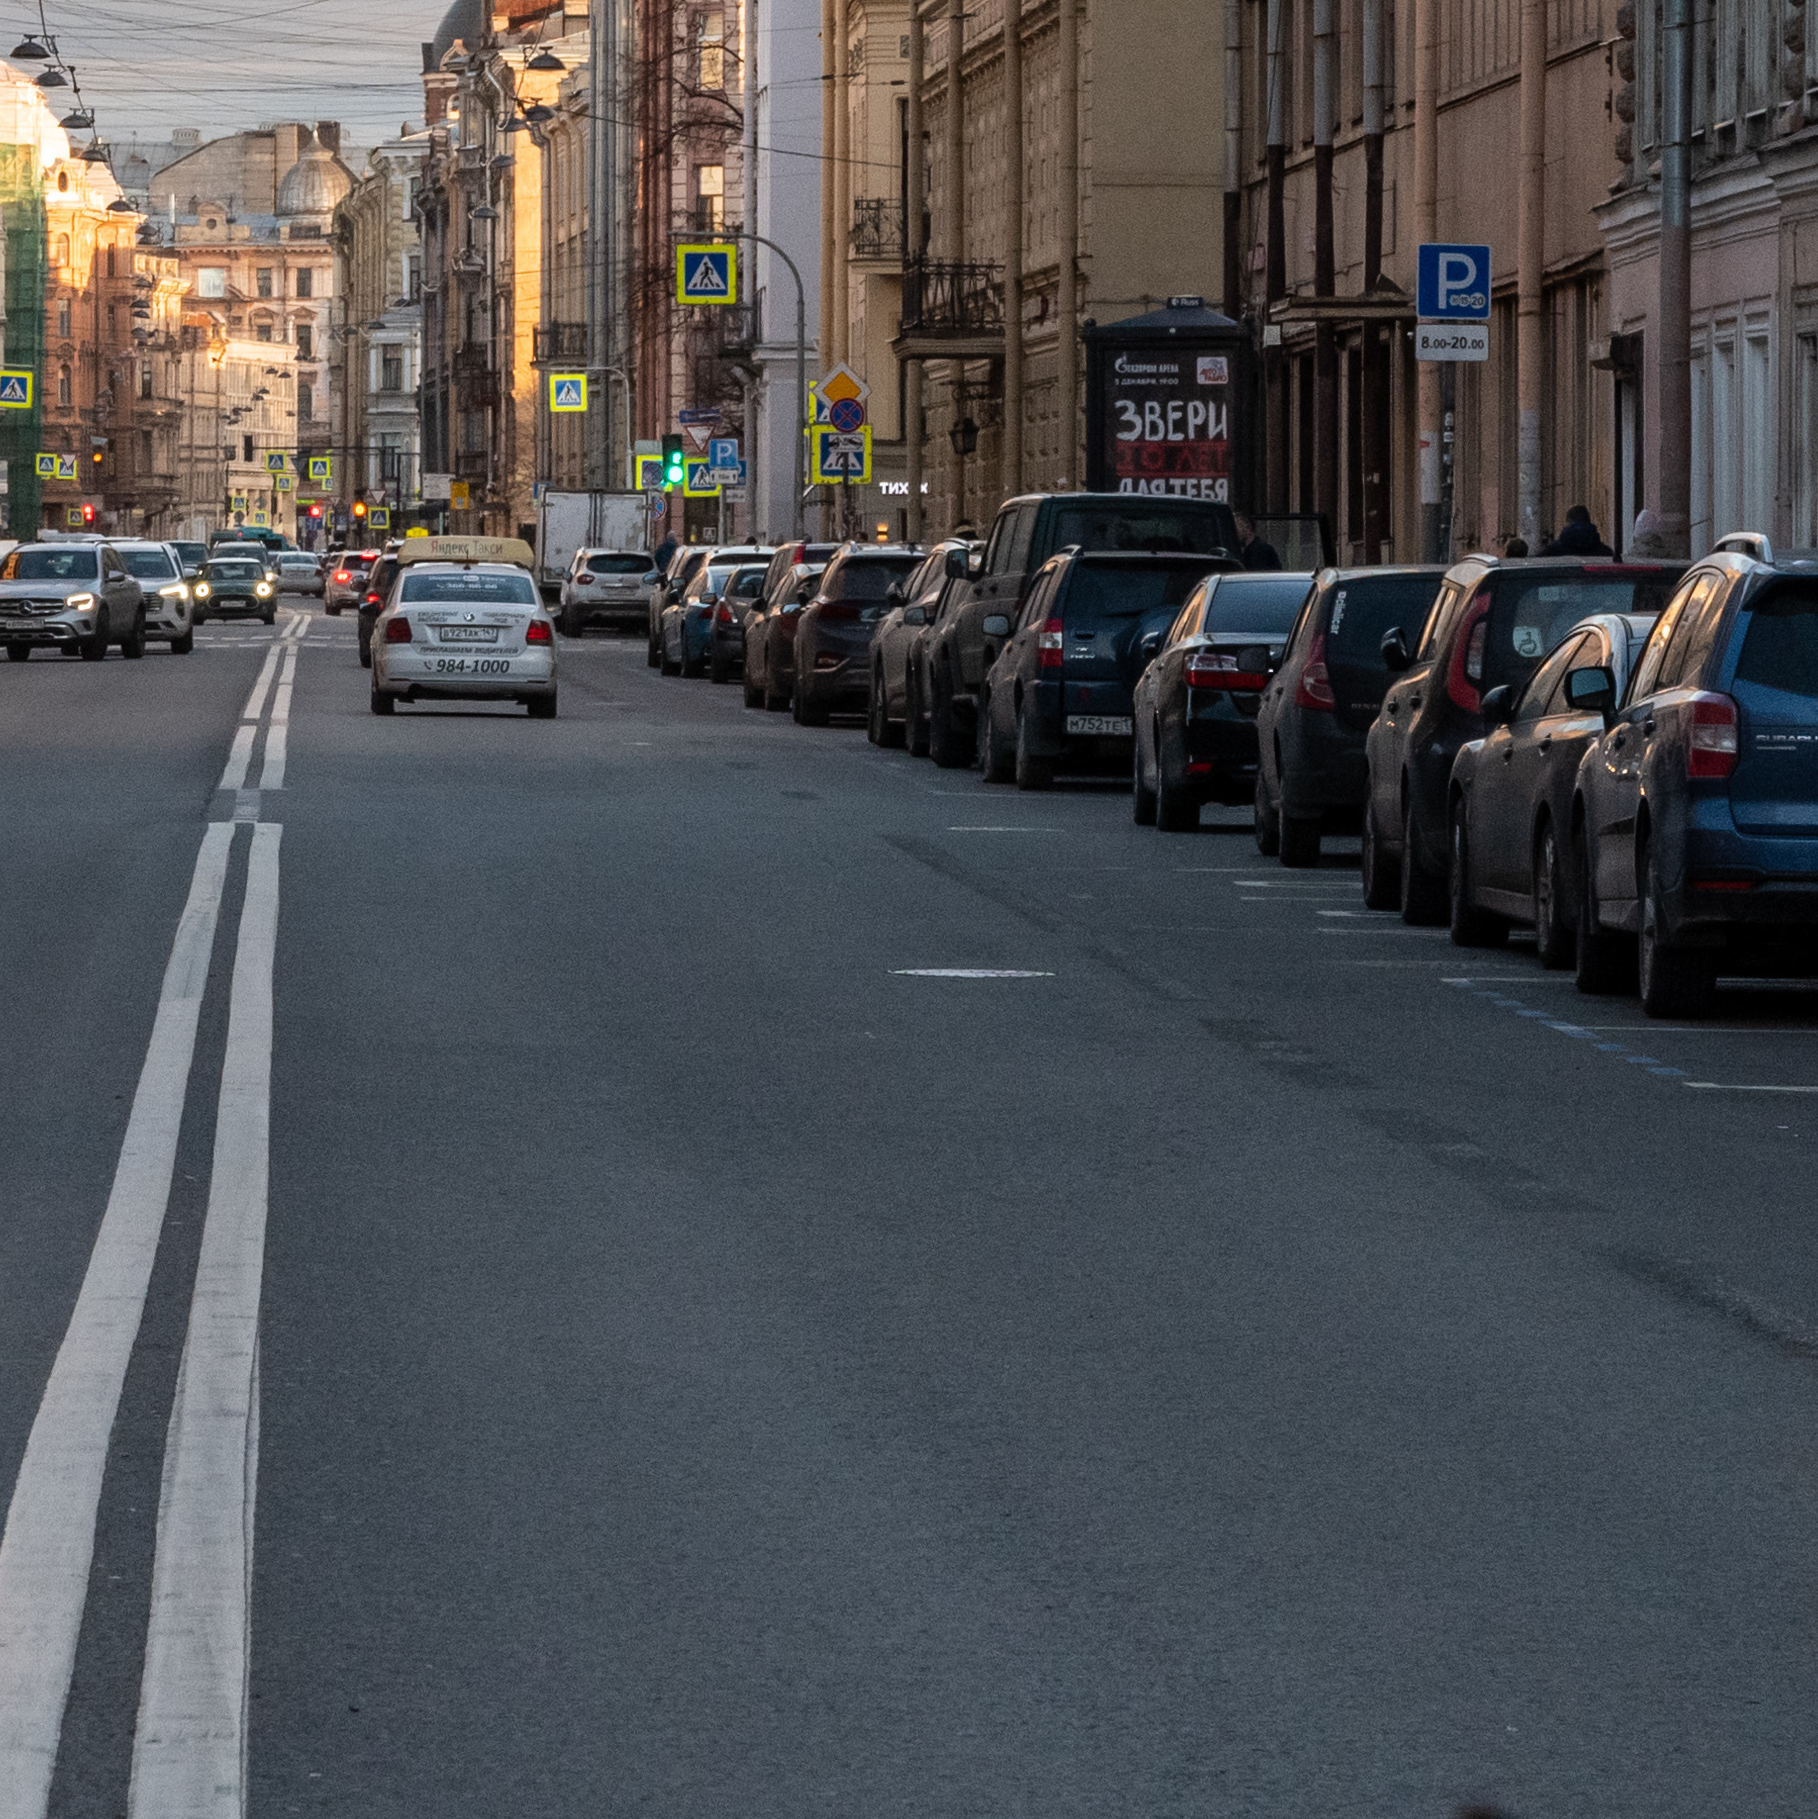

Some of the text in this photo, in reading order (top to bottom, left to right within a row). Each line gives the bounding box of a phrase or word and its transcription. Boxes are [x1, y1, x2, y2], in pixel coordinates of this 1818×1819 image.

[1472, 296, 1484, 306] 20
[1115, 399, 1228, 442] ЗВЕРИ
[431, 540, 503, 555] Яндекс Такси
[436, 659, 510, 673] 984-1000
